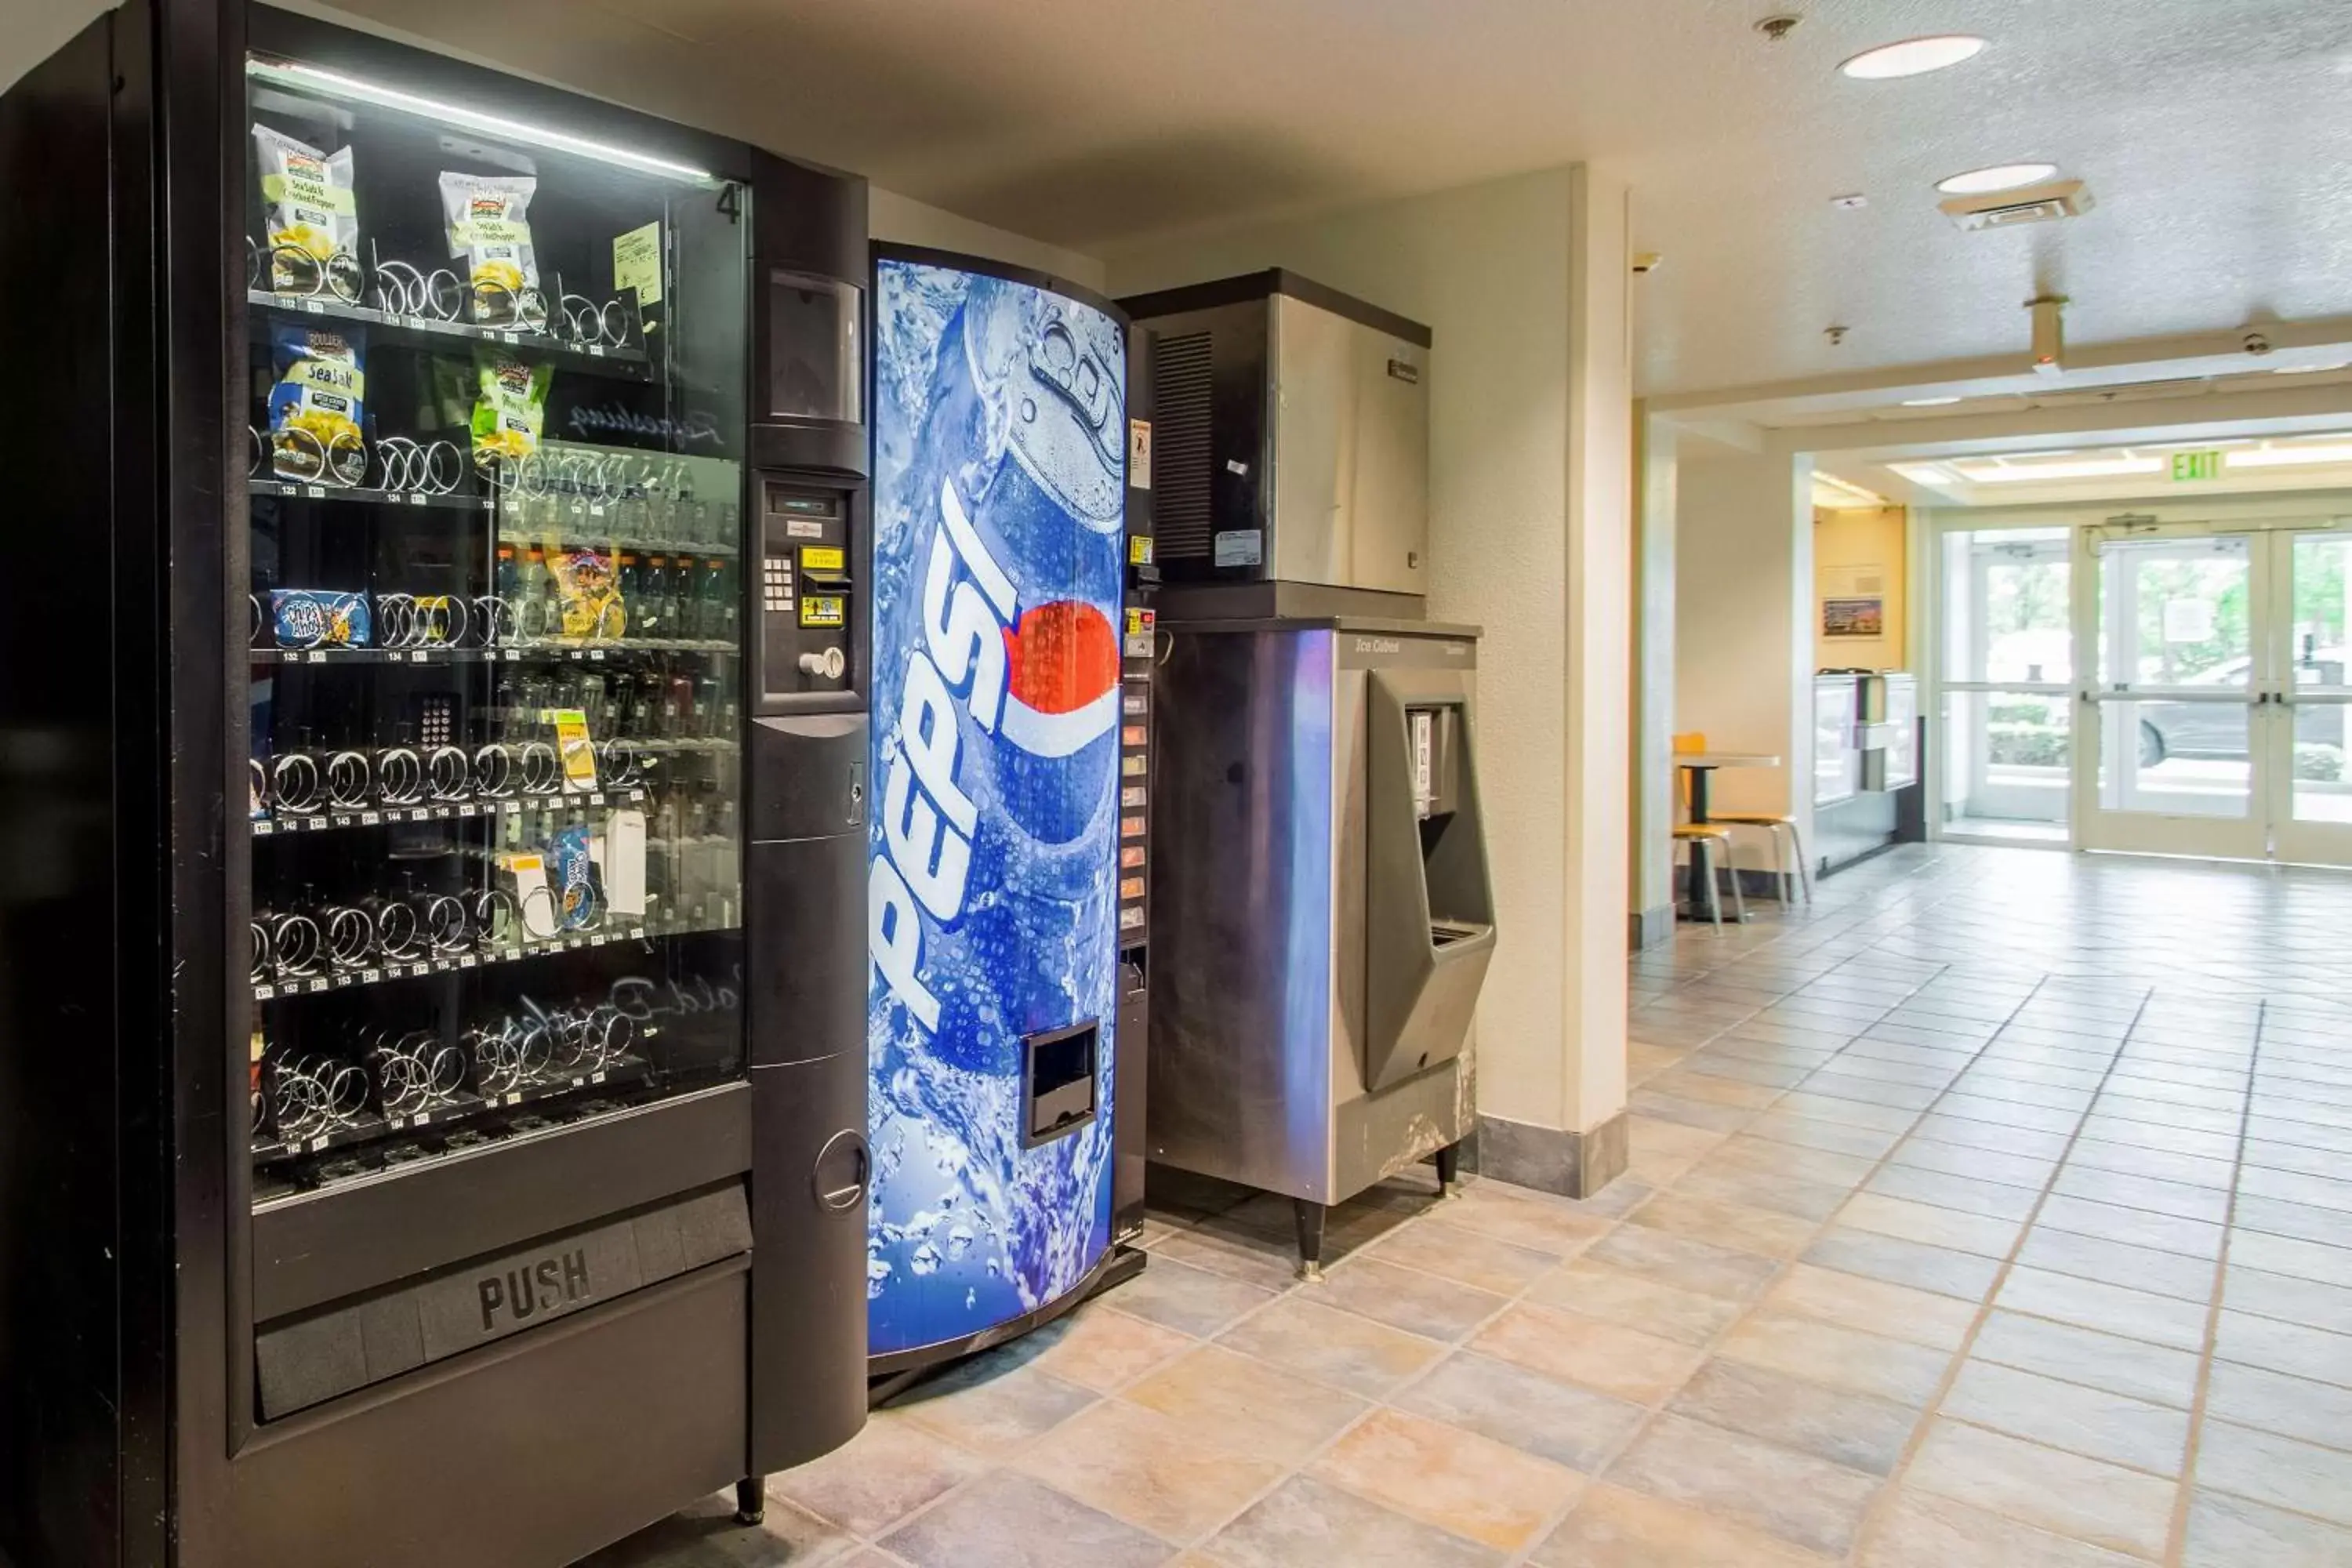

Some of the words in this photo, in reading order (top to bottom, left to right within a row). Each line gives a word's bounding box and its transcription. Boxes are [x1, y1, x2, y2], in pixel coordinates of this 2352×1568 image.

[717, 183, 740, 224] 4
[309, 364, 331, 380] Sea
[2173, 451, 2219, 481] EXIT
[870, 474, 1019, 1033] PEPSI
[387, 811, 401, 821] 144
[478, 1248, 590, 1331] PUSH
